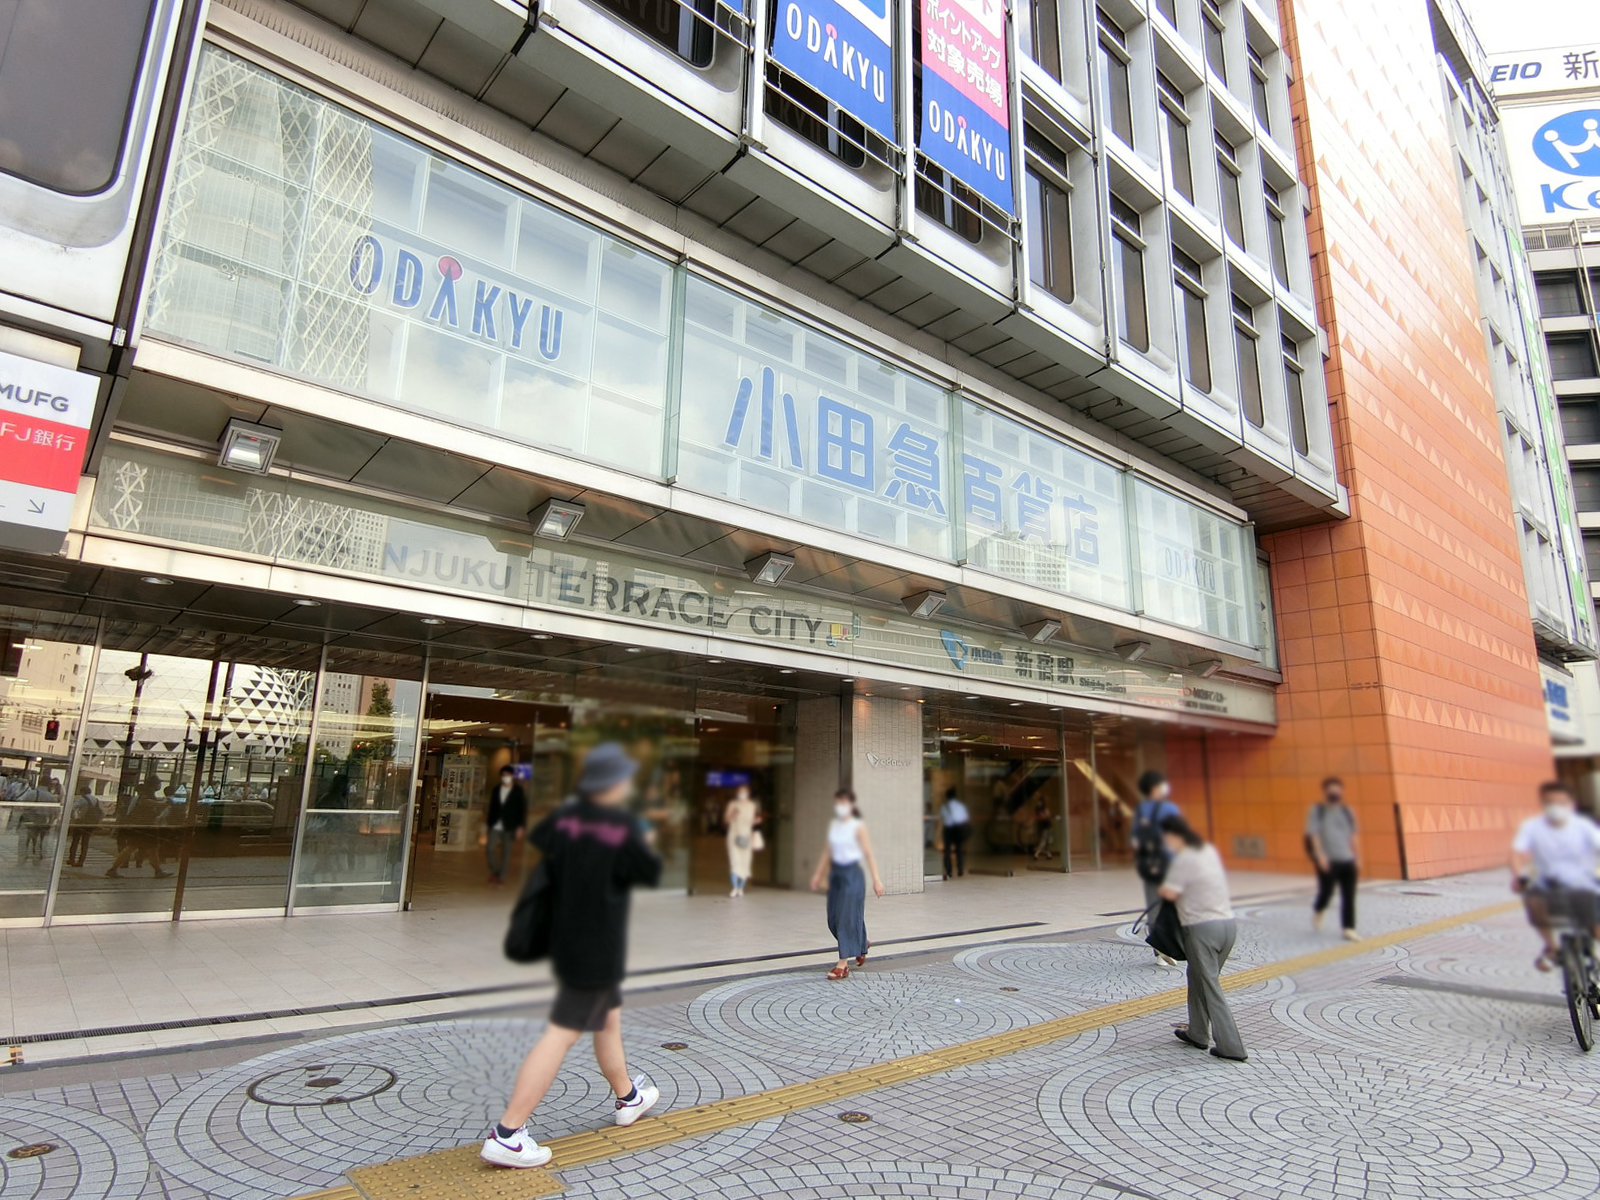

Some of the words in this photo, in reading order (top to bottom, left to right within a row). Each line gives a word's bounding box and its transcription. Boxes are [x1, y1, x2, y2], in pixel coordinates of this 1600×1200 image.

[785, 3, 885, 104] ODAKYU
[926, 0, 1001, 69] ポイントアップ
[927, 27, 1003, 108] 対象売場
[1490, 62, 1542, 82] EIO
[929, 99, 1006, 181] ODAKYU
[348, 234, 564, 361] ODAKYU
[0, 383, 70, 412] MUFG
[723, 366, 1099, 566] 小田急百貨店
[526, 561, 731, 628] TERRACE
[749, 605, 823, 644] CITY
[1165, 547, 1216, 592] ODAKYU
